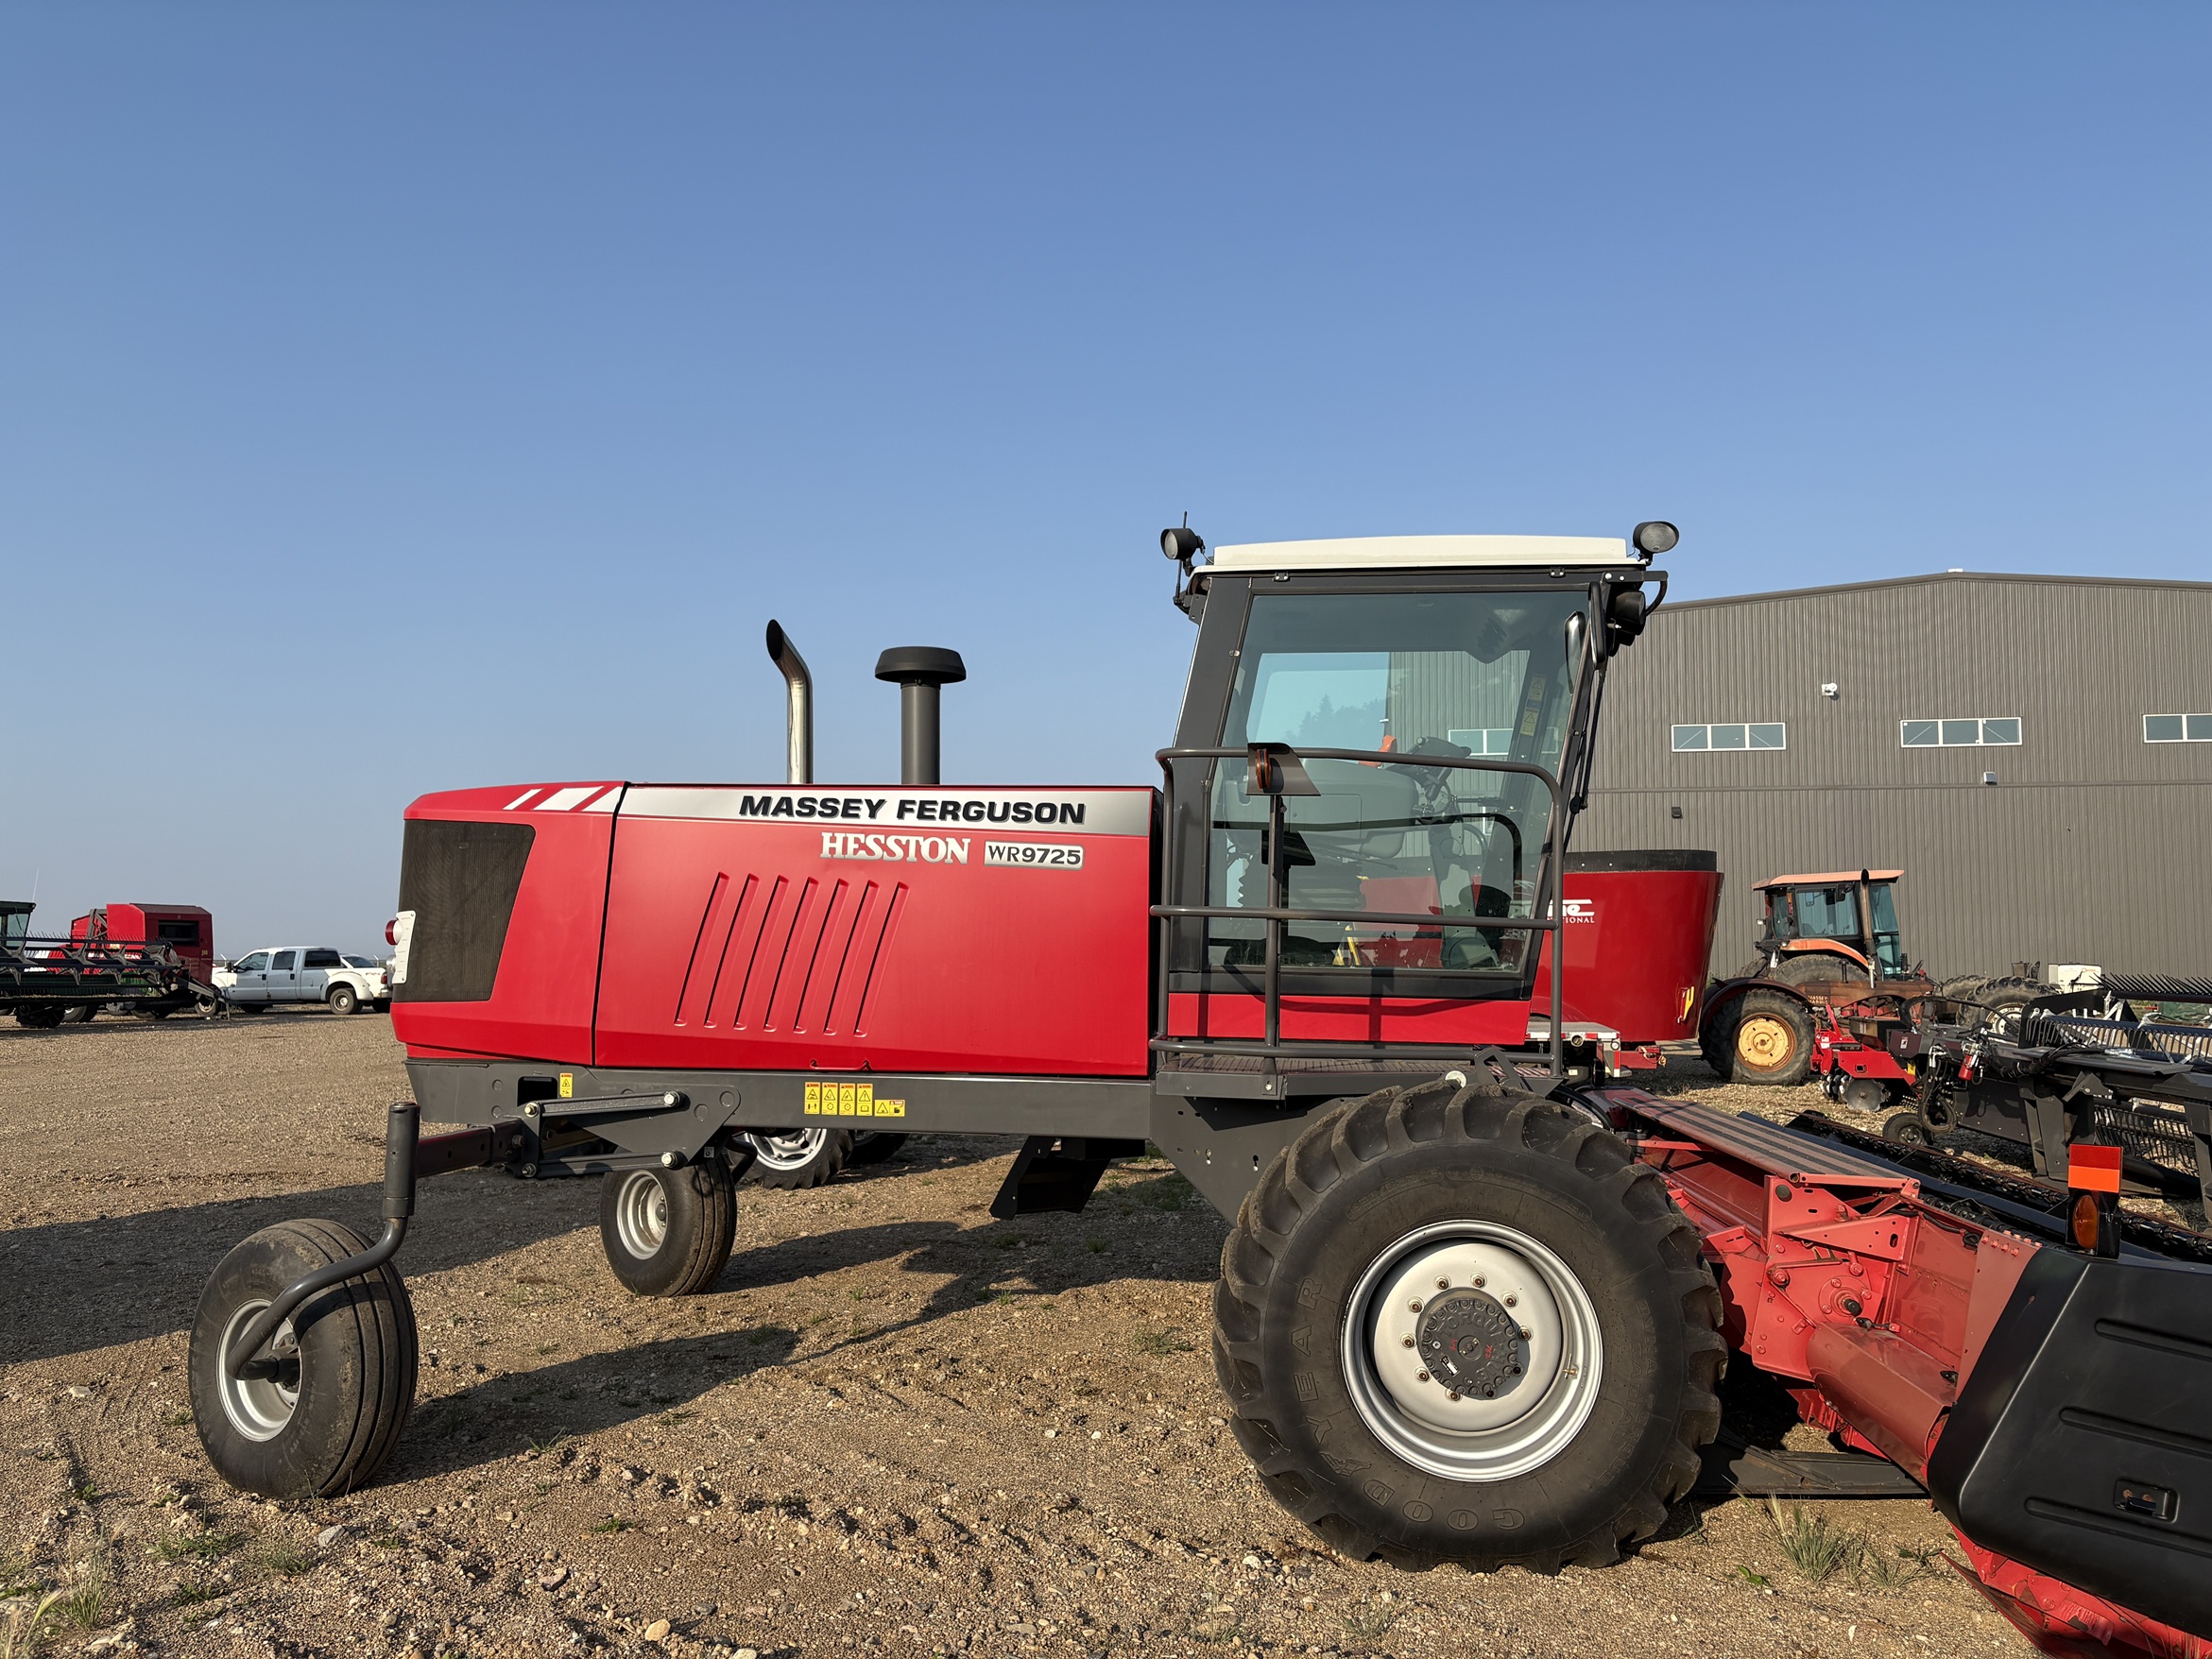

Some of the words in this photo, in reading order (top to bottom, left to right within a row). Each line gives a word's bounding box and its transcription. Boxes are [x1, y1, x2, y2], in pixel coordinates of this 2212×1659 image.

[739, 795, 887, 819] MASSEY
[897, 799, 1086, 825] FERGUSON
[820, 831, 971, 864] HESSTON
[987, 845, 1082, 865] WR9725
